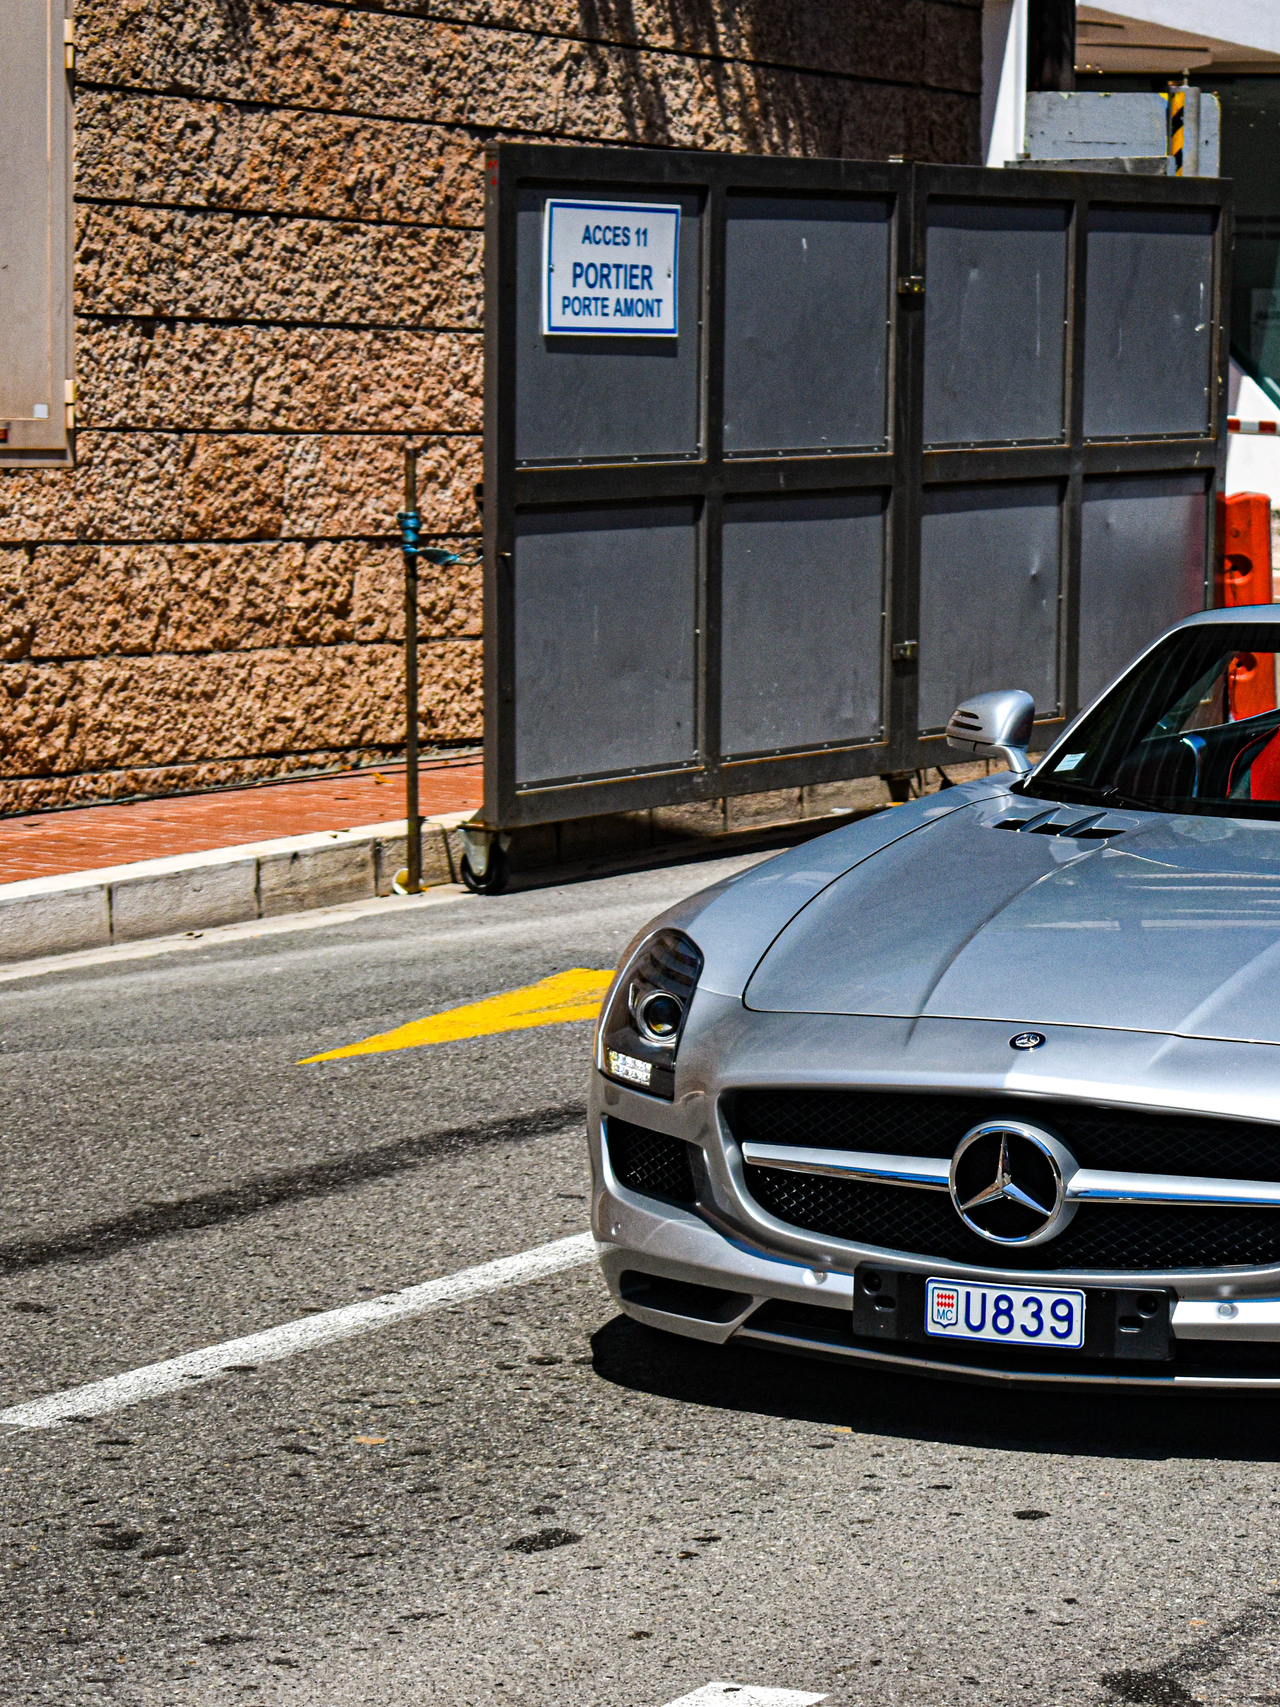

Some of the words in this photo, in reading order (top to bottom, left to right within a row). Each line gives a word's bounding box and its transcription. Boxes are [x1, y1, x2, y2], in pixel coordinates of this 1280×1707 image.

[581, 225, 631, 246] ACCES
[635, 227, 648, 247] 11
[572, 261, 654, 291] PORTIER
[562, 295, 610, 317] PORTE
[613, 297, 663, 318] AMONT
[936, 1308, 954, 1321] MC
[964, 1290, 1074, 1340] U839
